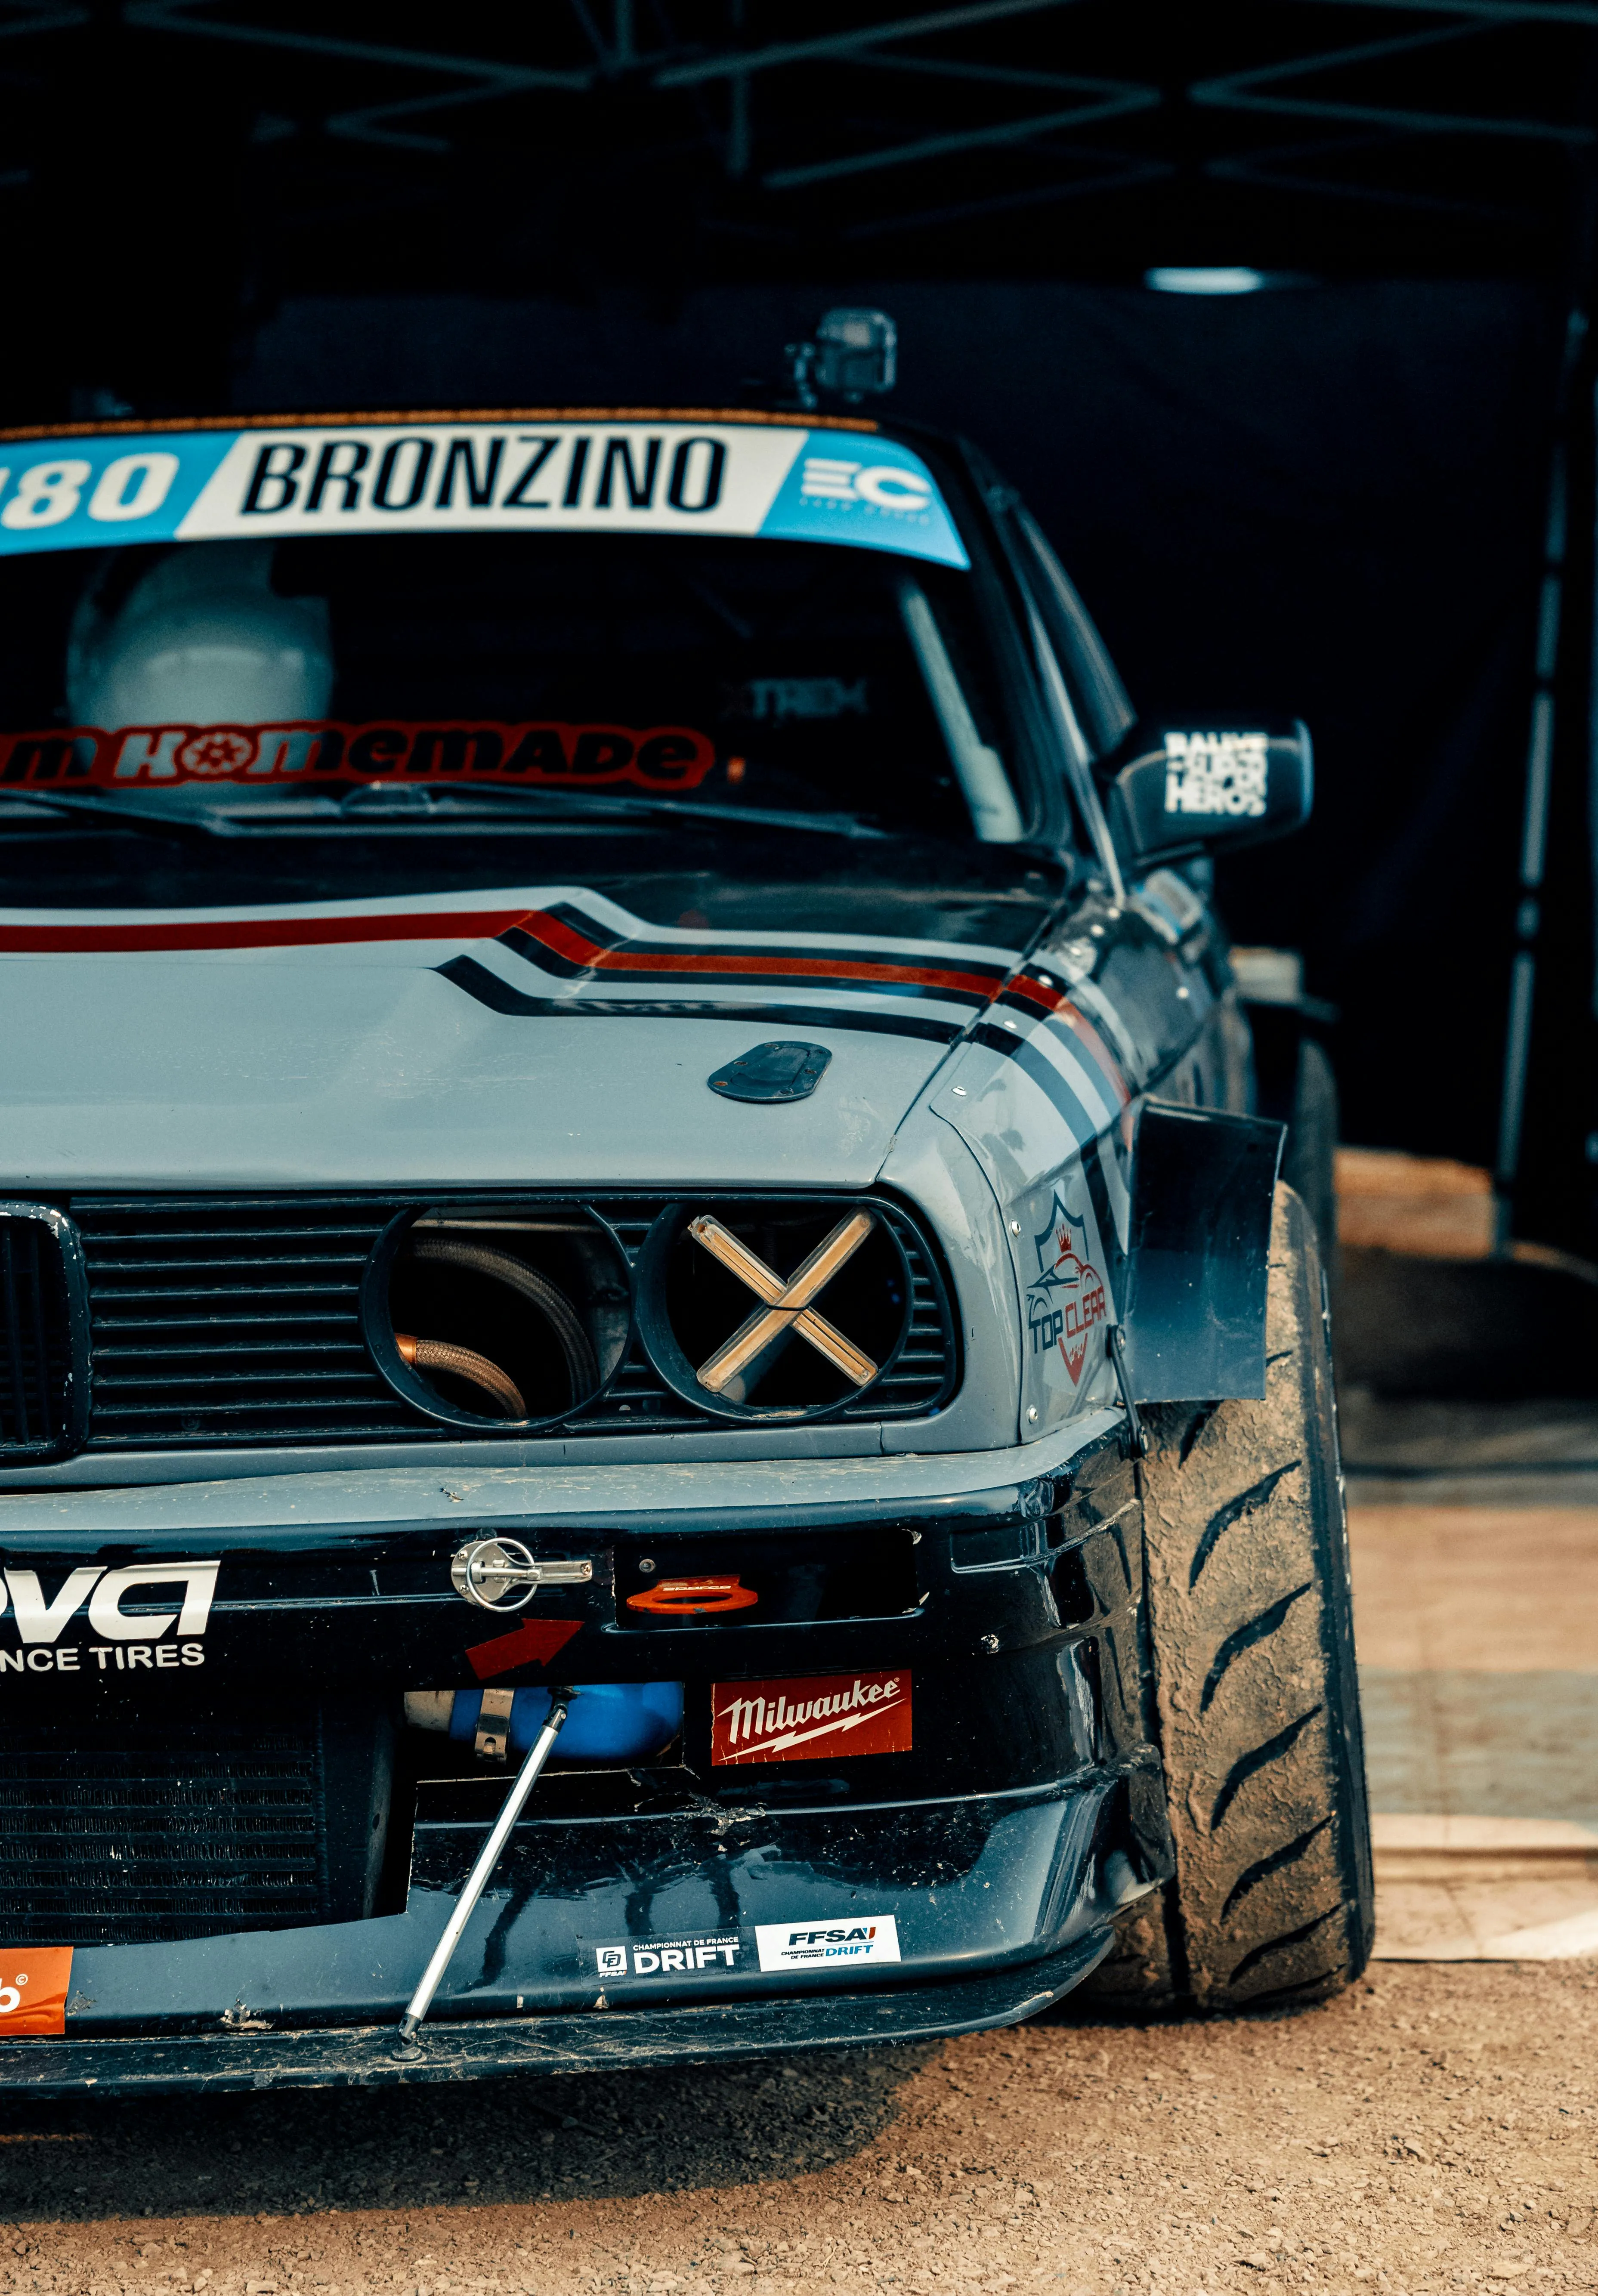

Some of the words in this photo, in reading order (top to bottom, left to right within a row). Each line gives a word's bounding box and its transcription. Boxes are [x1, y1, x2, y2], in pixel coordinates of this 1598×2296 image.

[0, 460, 179, 530] 80
[240, 436, 729, 516] BRONZINO
[1029, 1309, 1063, 1354] TOP
[1065, 1285, 1107, 1338] CLEAR
[0, 1561, 221, 1643] va
[89, 1643, 205, 1670] TIRES
[717, 1680, 900, 1744] Milwaukee
[633, 1941, 692, 1951] CHAMPIONNAT
[707, 1937, 739, 1945] FRANCE
[634, 1944, 740, 1974] DRIFT
[789, 1928, 867, 1946] FFSA
[825, 1945, 874, 1956] DRIFT
